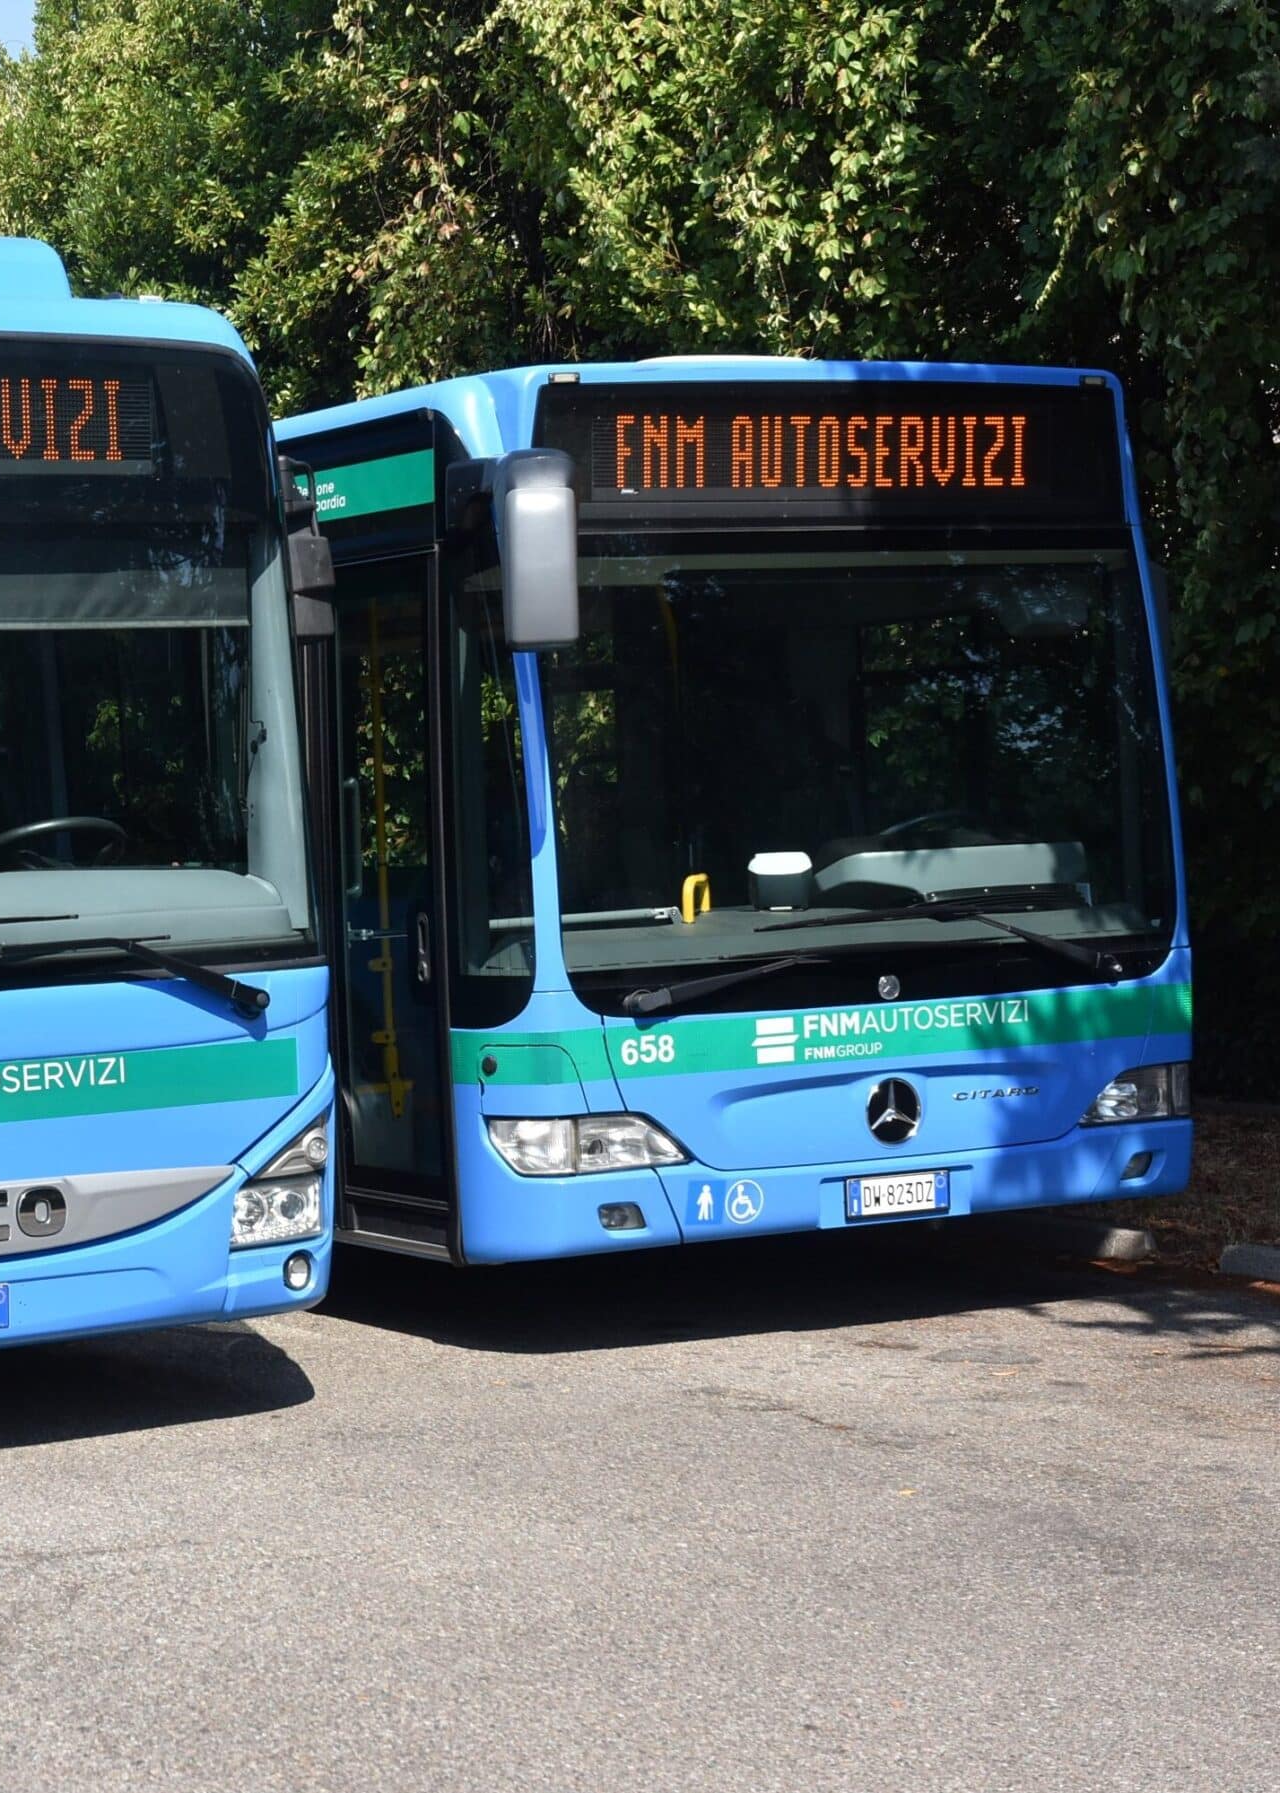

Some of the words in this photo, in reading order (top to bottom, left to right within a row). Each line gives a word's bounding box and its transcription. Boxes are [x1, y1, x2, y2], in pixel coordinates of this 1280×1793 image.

[616, 415, 705, 488] FNM
[731, 415, 1027, 488] AUTOSERVIZI
[621, 1034, 676, 1066] 658
[952, 1086, 1040, 1101] CITARO
